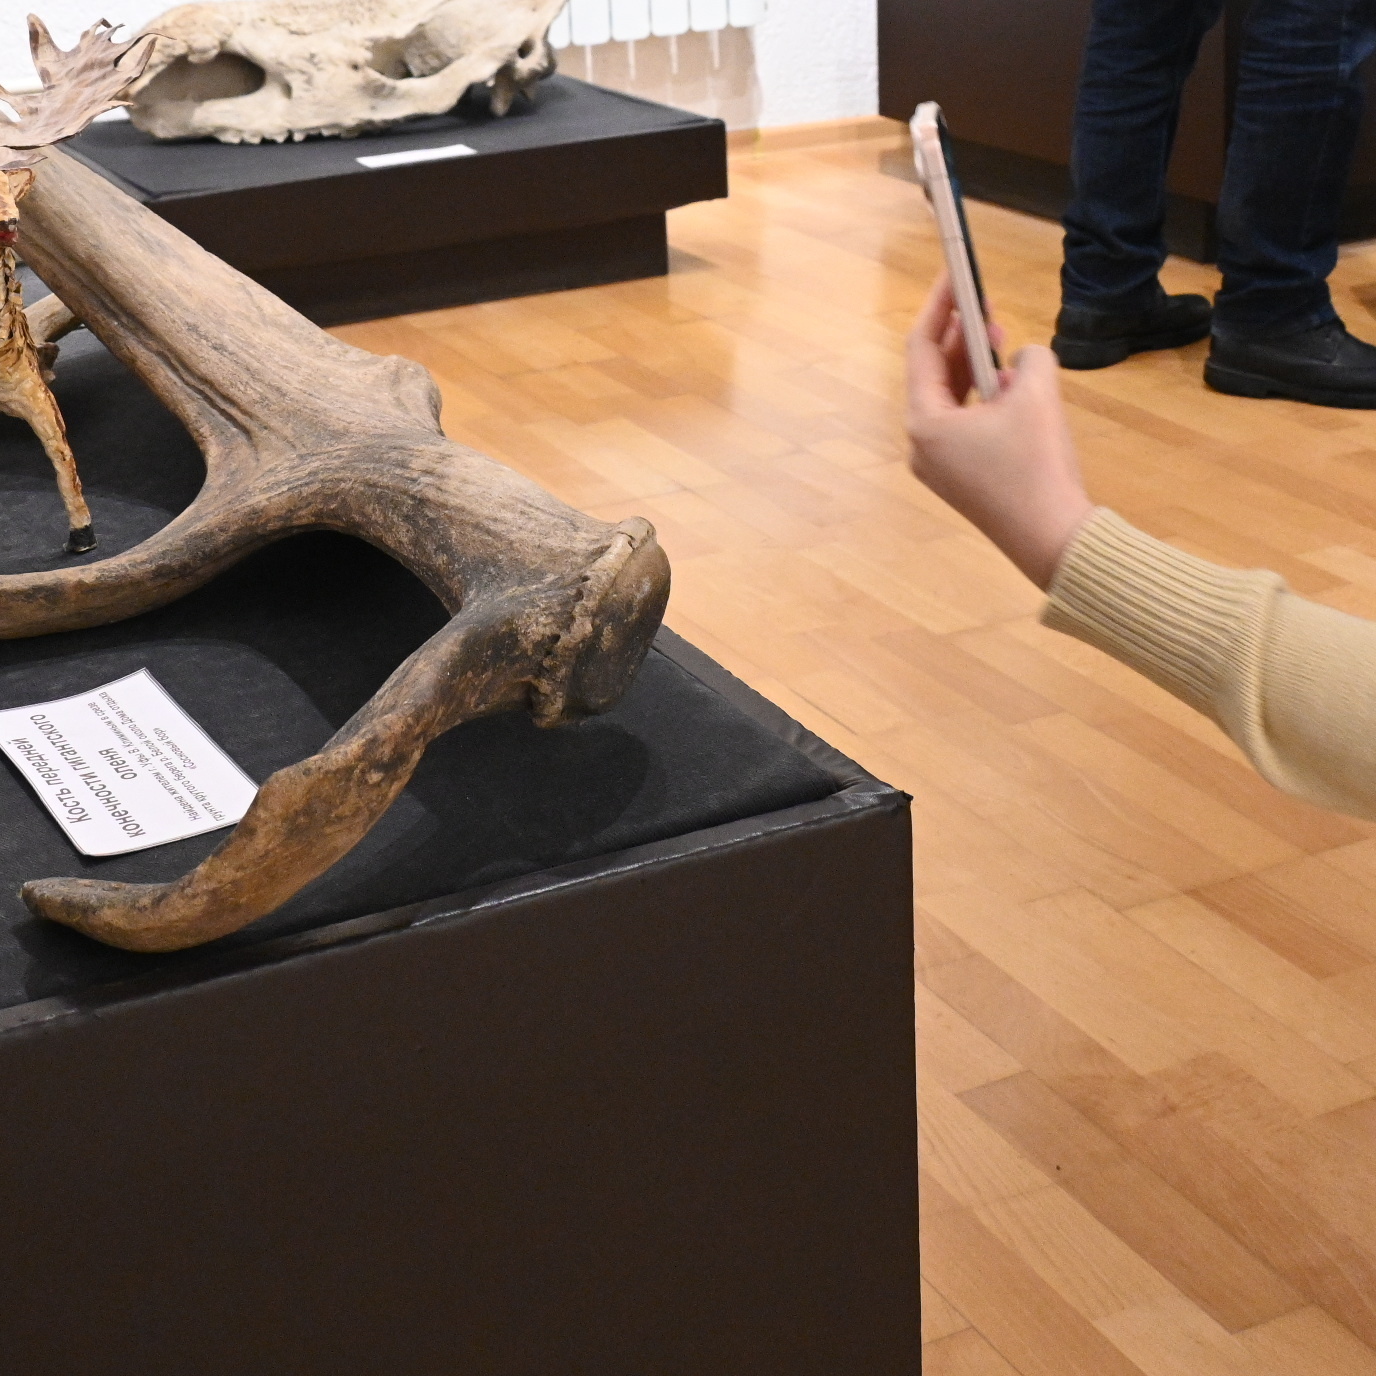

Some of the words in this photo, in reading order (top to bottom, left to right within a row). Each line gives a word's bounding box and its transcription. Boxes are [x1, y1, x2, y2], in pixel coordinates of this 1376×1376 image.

[87, 701, 106, 717] срезе
[98, 691, 121, 711] отдыха
[29, 714, 85, 771] гигантского
[152, 727, 170, 742] бор»
[134, 752, 153, 768] Уфы
[140, 739, 164, 758] Белой
[162, 739, 197, 770] «Сосновый
[7, 737, 64, 786] передней
[97, 747, 138, 780] оленя
[163, 761, 186, 782] берега
[152, 771, 180, 796] жителем
[181, 780, 207, 803] крутого
[56, 787, 92, 825] Кость
[79, 771, 146, 838] конечности
[173, 795, 201, 822] Найдена
[201, 801, 226, 822] грунта
